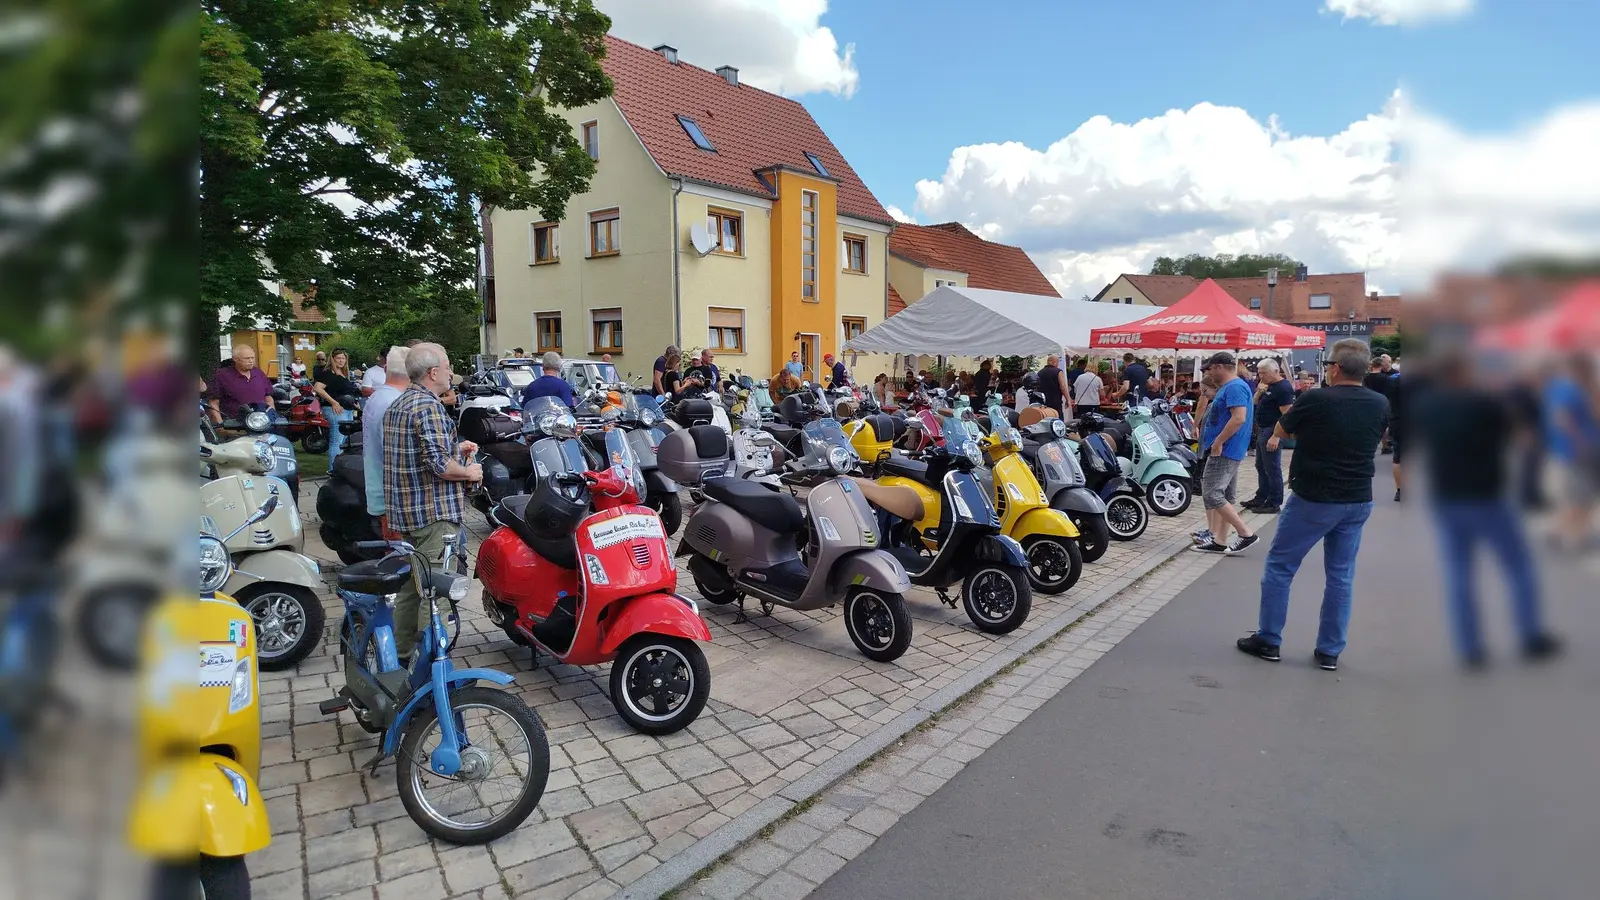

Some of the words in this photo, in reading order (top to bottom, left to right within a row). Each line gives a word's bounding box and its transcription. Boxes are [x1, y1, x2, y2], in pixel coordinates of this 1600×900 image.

[1140, 315, 1208, 326] MOTUL
[1098, 332, 1143, 345] MOTUL
[1175, 332, 1228, 345] MOTUL
[1245, 333, 1276, 346] MOTUL
